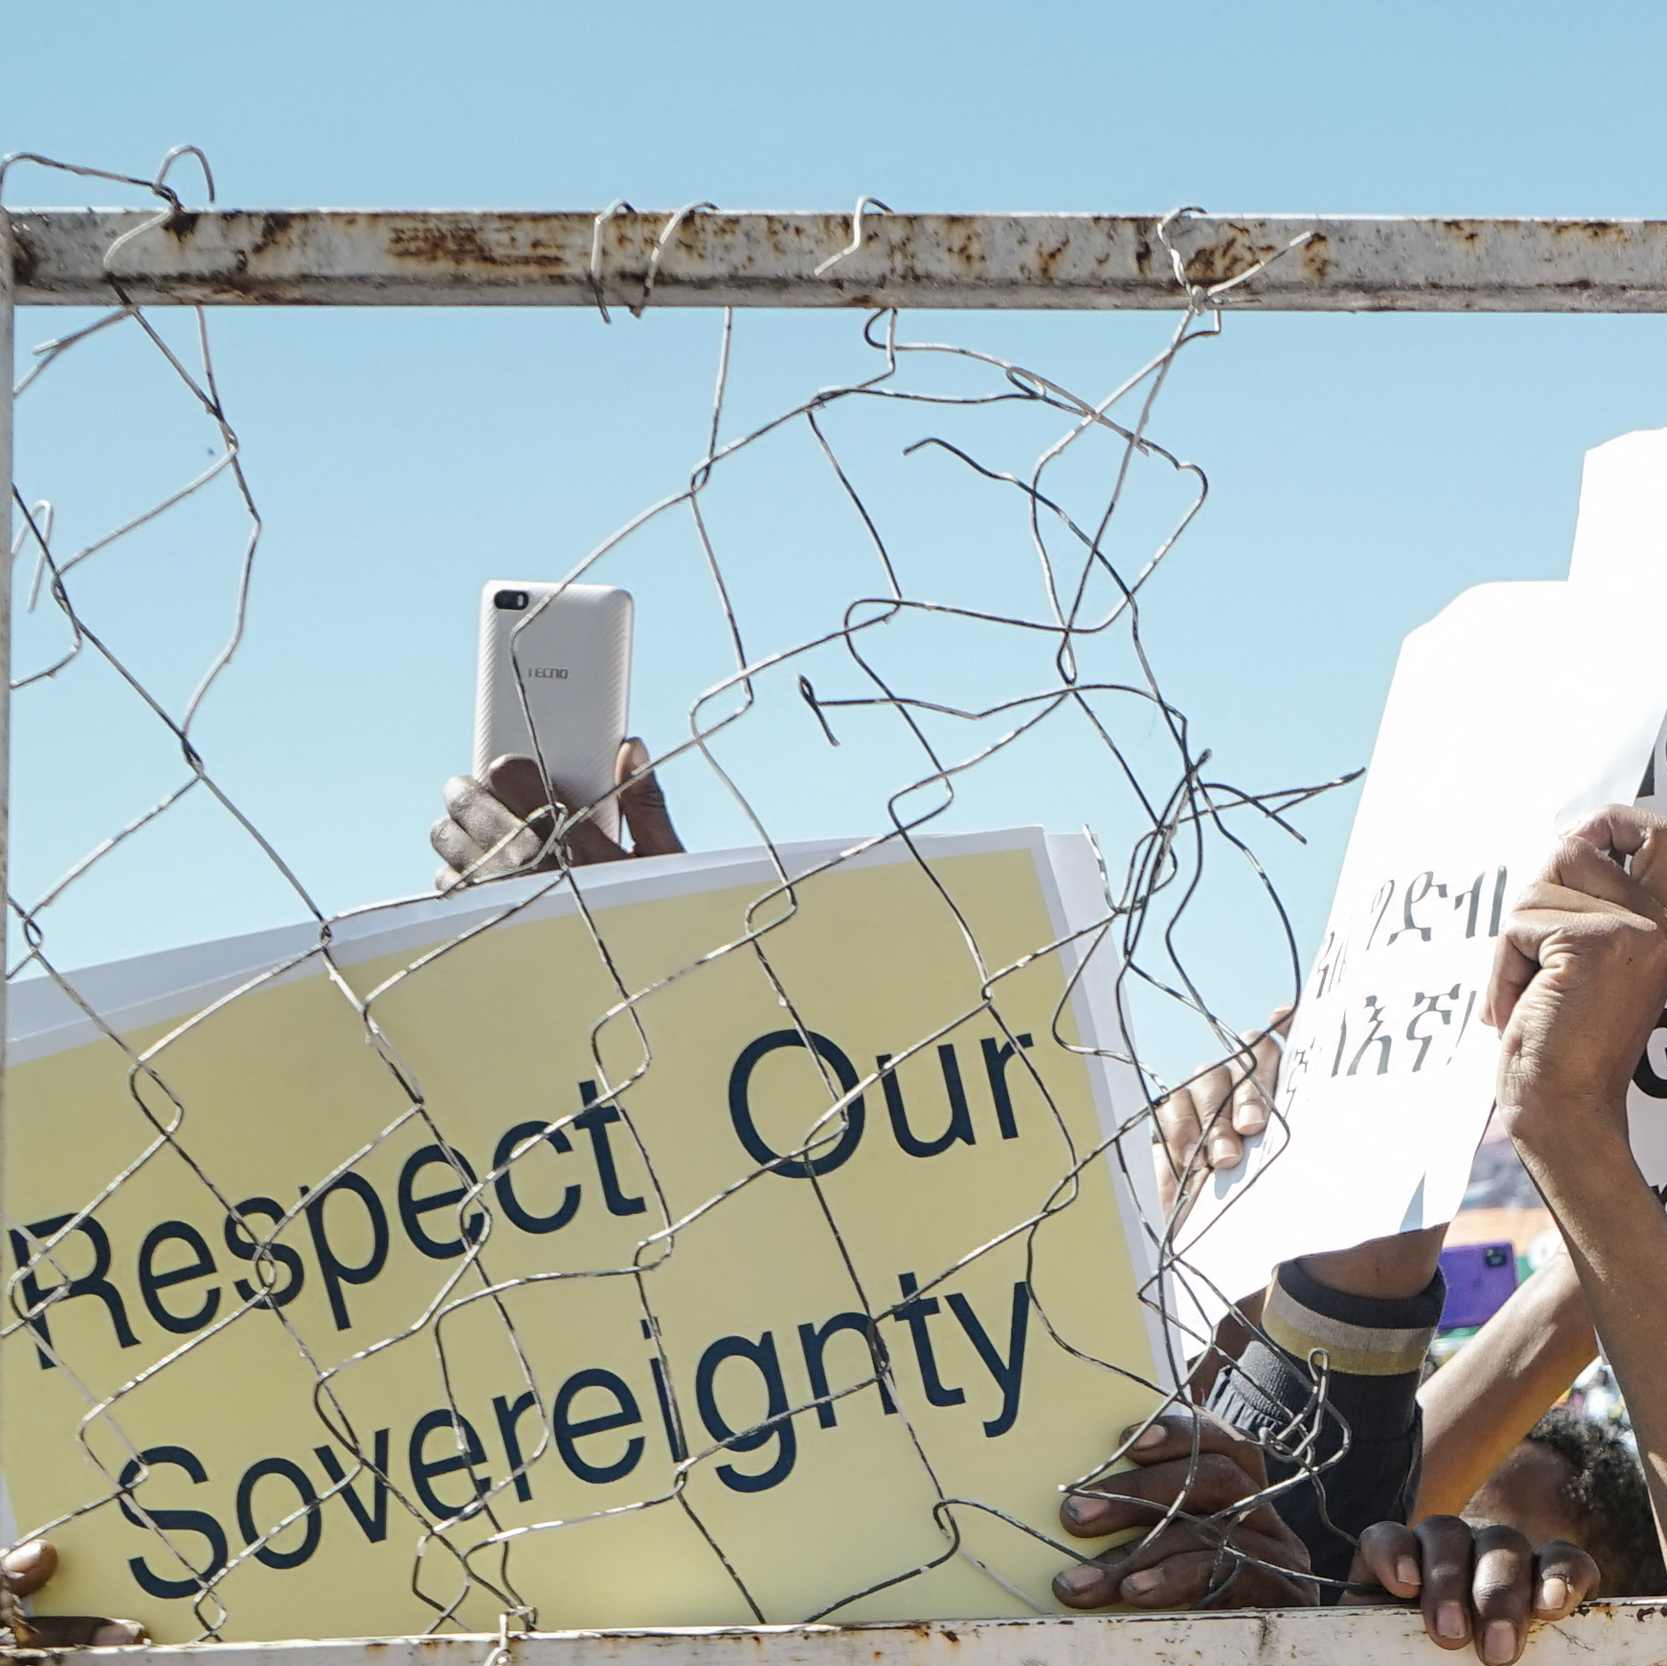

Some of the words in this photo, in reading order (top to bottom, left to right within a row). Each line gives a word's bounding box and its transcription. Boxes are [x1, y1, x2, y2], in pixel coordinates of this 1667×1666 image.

[8, 1080, 648, 1371] Respect
[727, 1028, 1034, 1179] Our
[116, 1270, 1032, 1599] Sovereignty
